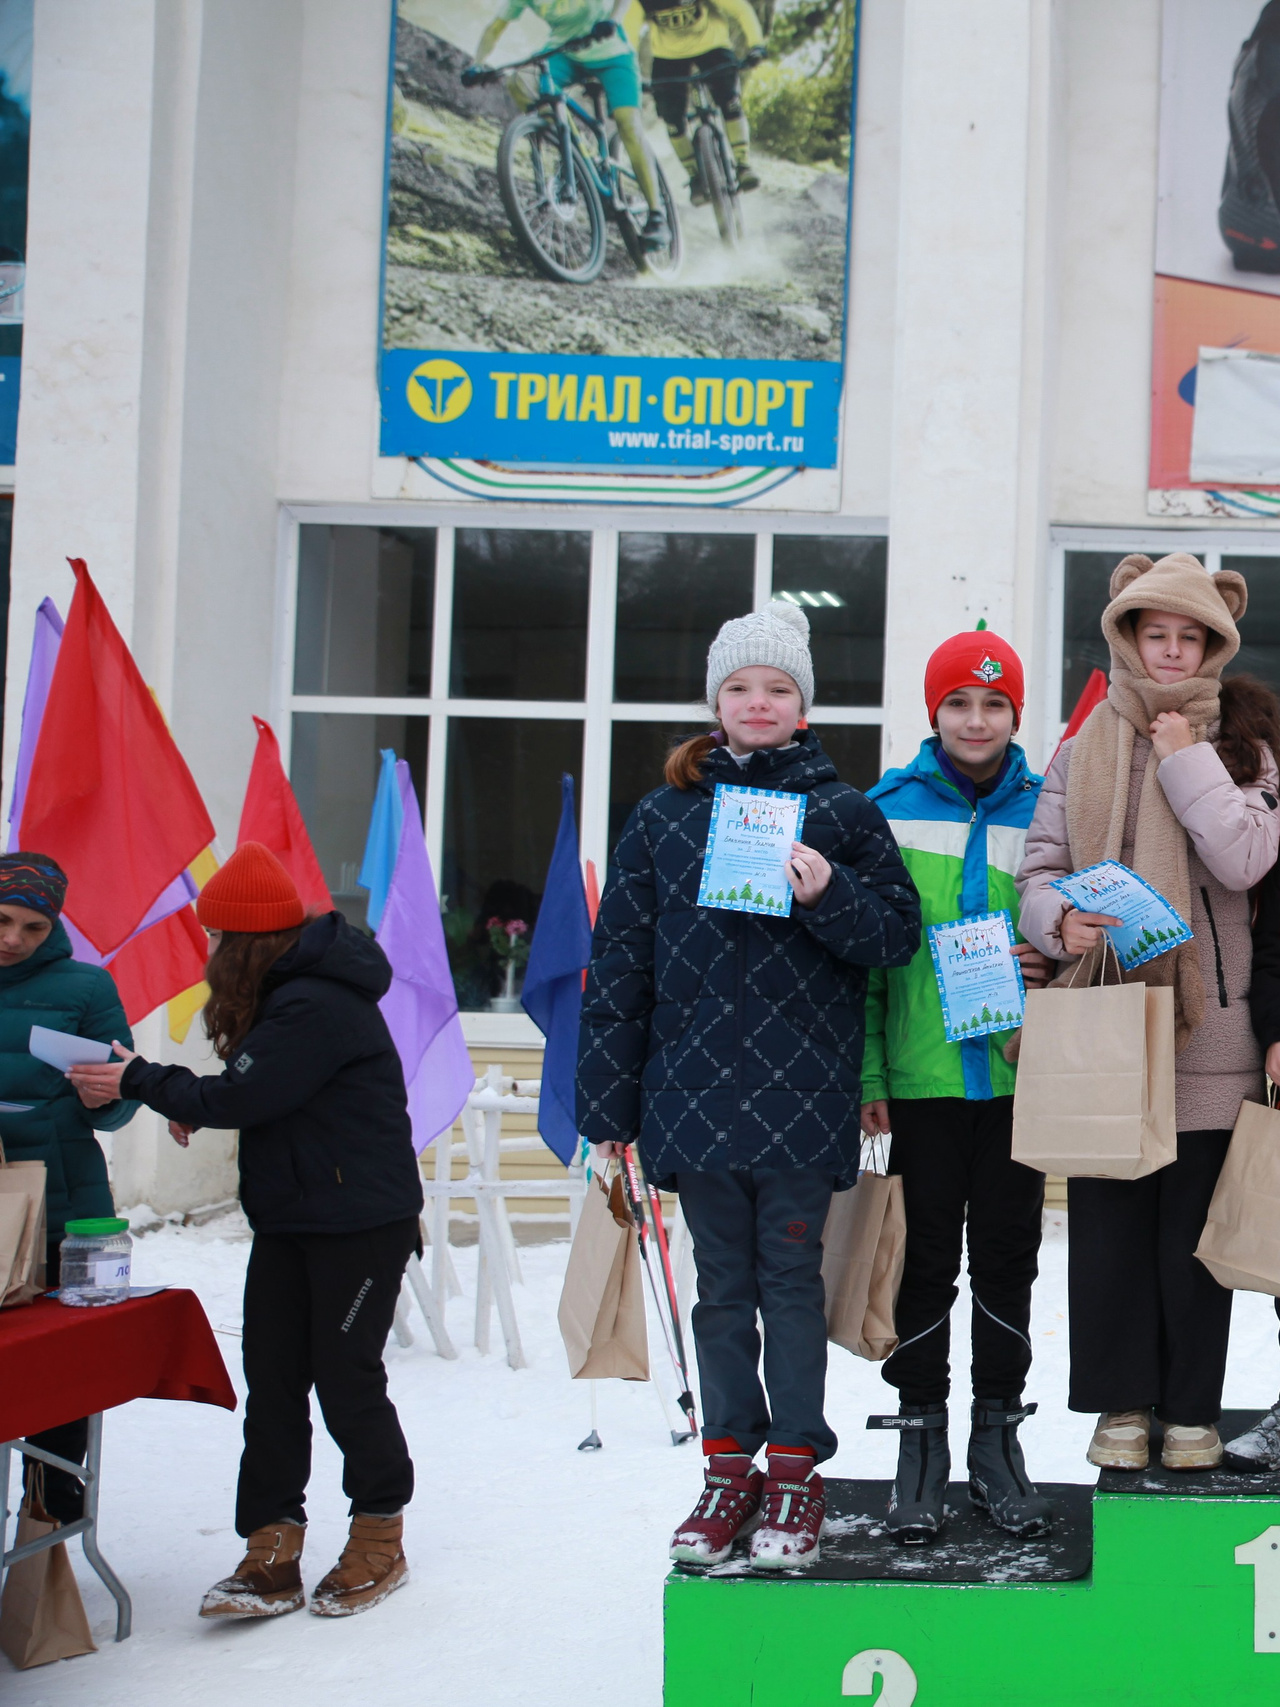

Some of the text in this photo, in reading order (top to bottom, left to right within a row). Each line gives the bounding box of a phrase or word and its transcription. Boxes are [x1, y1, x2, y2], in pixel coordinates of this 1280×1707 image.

[608, 429, 805, 454] www.trial-sport.ru
[726, 819, 785, 836] ГРАМОТА
[1083, 879, 1130, 904] ГРАМОТА
[947, 944, 1002, 965] ГРАМОТА
[627, 1162, 642, 1202] NORDWAY
[341, 1277, 374, 1333] noname
[882, 1418, 924, 1426] SPINE
[777, 1482, 810, 1493] TOREAD
